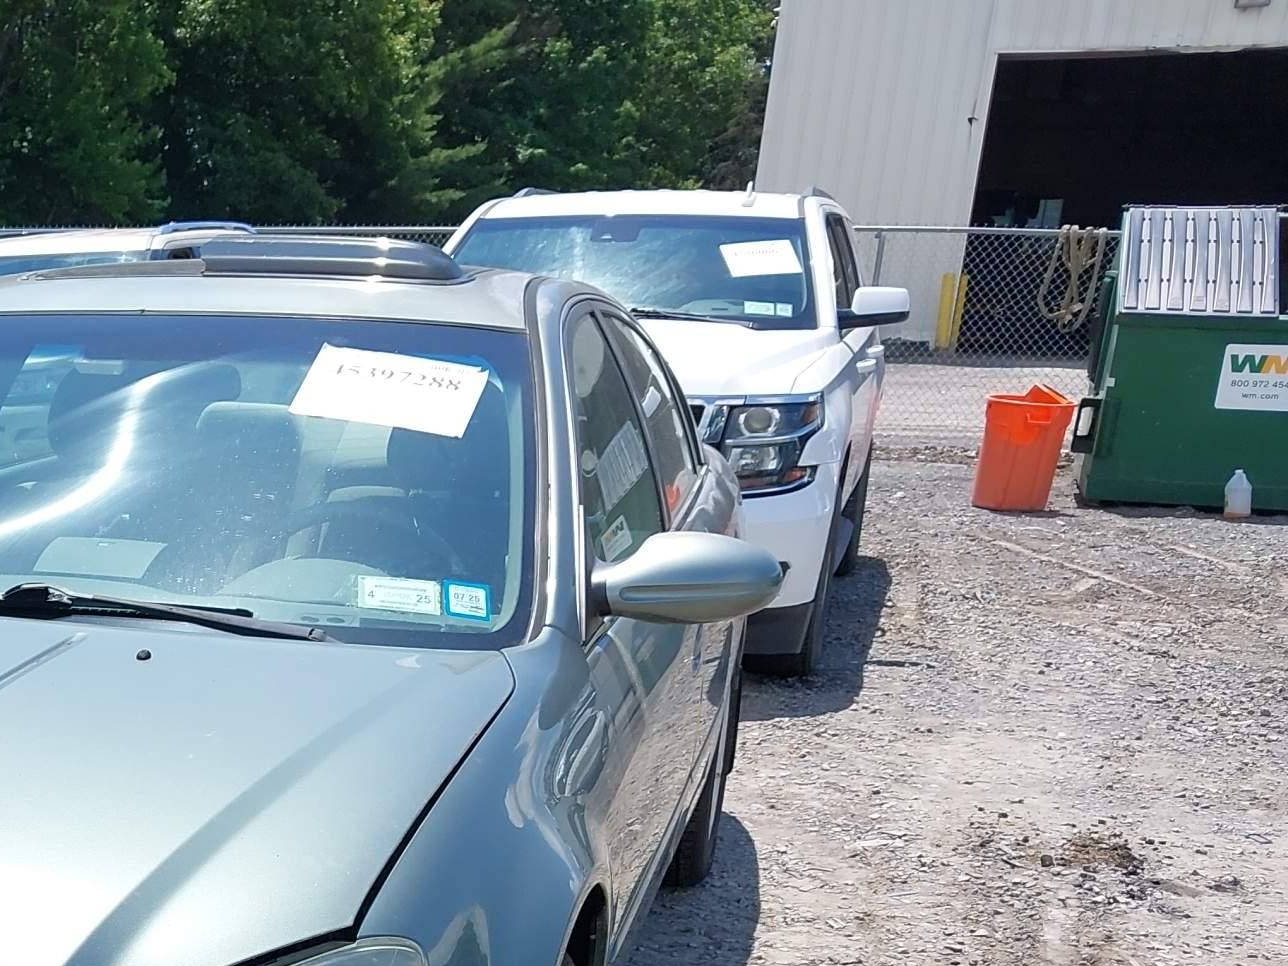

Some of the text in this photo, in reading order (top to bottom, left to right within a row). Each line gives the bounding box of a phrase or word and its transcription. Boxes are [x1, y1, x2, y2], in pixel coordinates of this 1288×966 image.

[1230, 380, 1249, 388] 800
[416, 594, 432, 604] 25
[453, 592, 465, 601] 07
